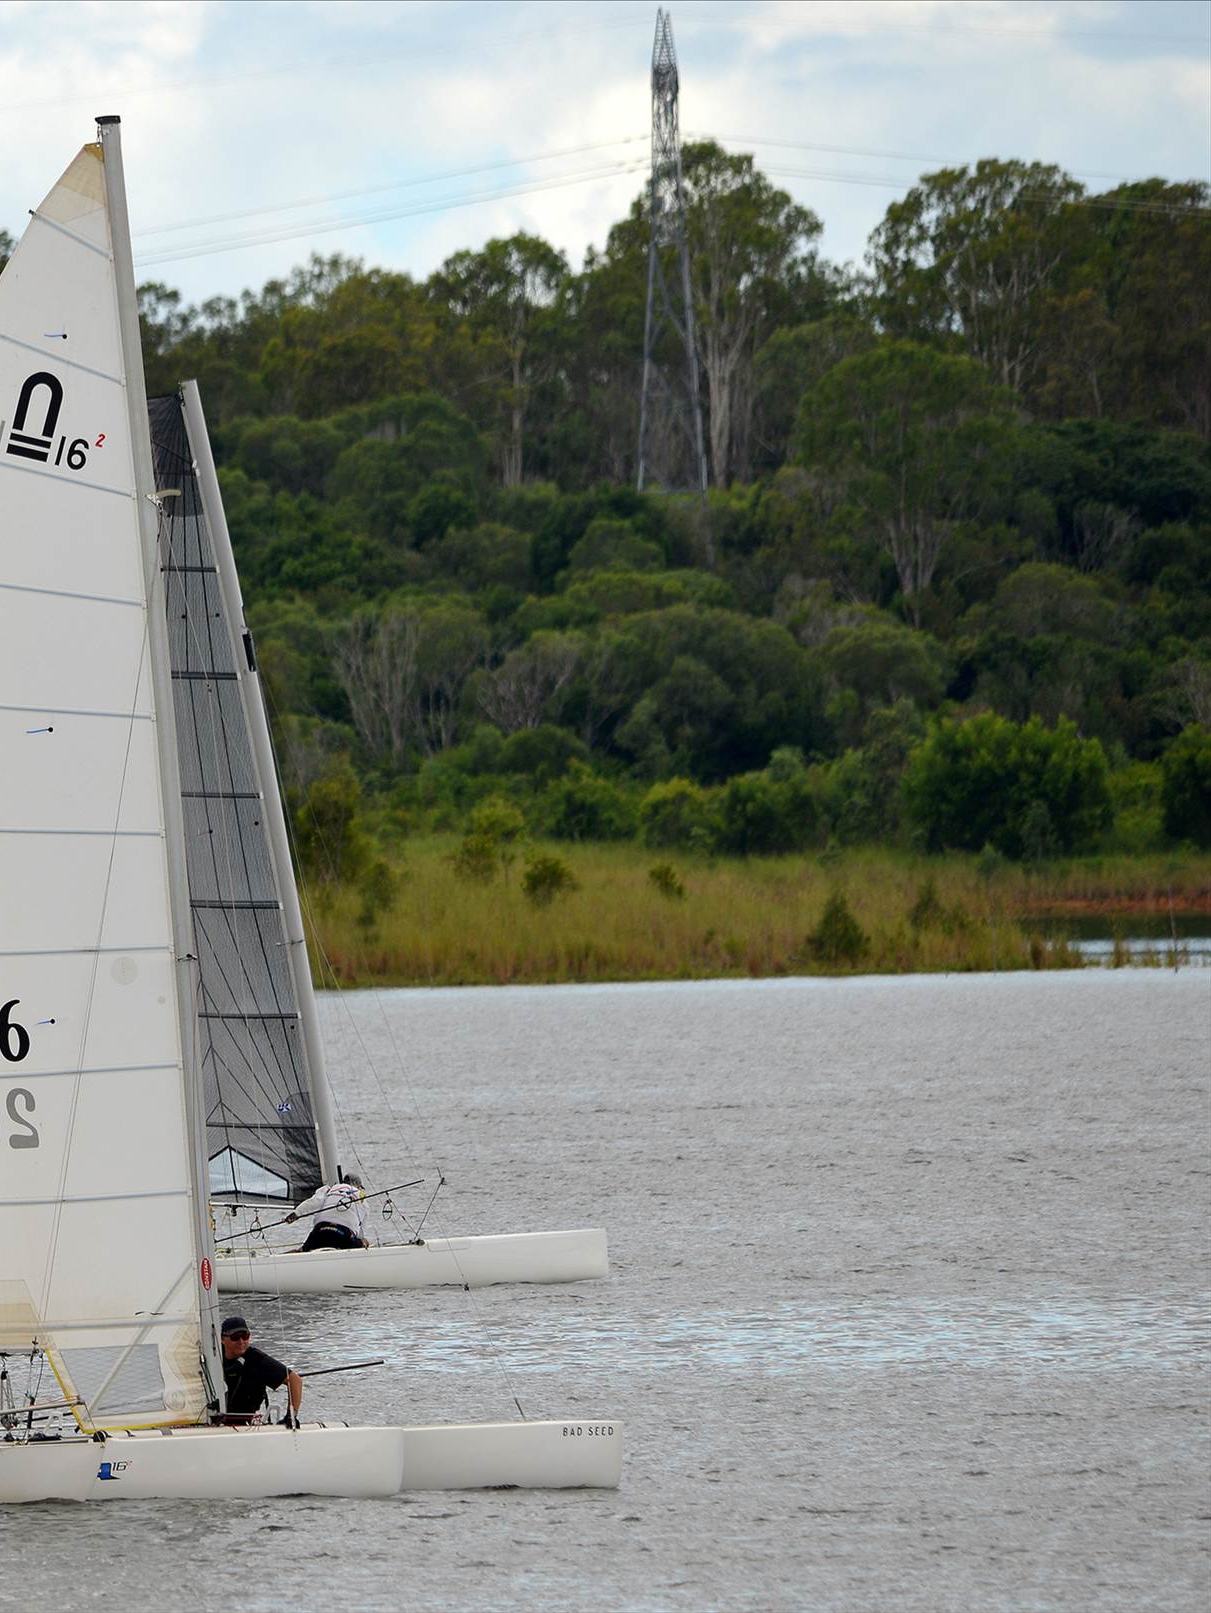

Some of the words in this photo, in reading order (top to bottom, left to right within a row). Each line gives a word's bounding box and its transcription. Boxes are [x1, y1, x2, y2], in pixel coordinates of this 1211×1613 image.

[54, 436, 89, 470] 16
[562, 1426, 582, 1436] BAD
[588, 1426, 614, 1436] SEED
